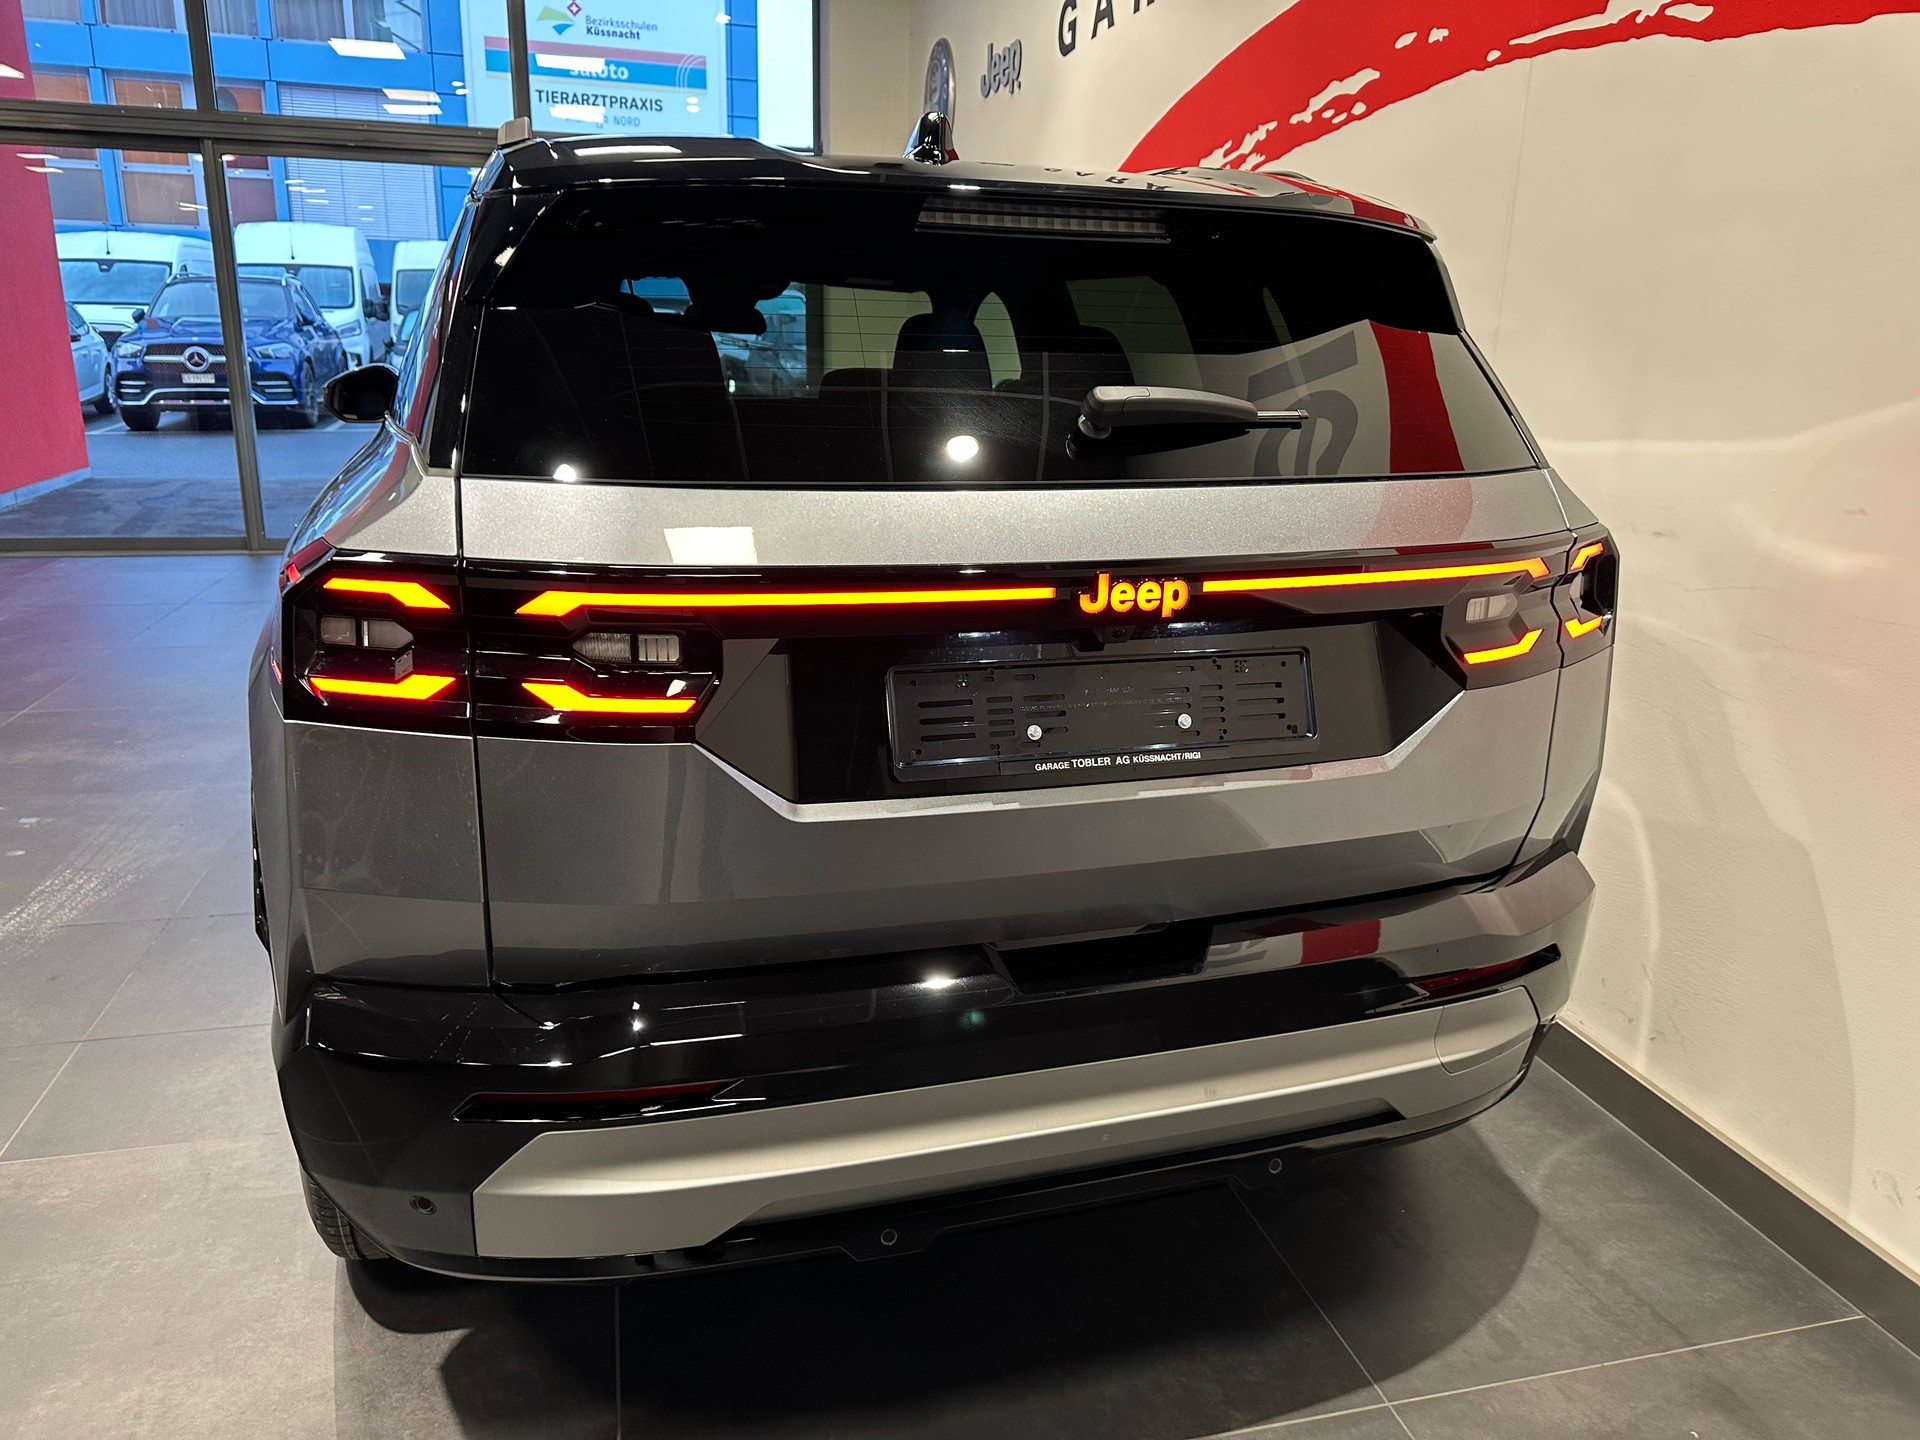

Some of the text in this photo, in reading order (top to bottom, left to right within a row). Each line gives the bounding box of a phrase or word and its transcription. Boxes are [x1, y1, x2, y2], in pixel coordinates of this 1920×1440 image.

[585, 15, 658, 32] Bezirksschulen
[586, 26, 641, 40] Küssnacht
[1058, 0, 1155, 57] GA
[981, 39, 1022, 98] Jeep
[535, 89, 663, 112] TIERARZTPRAXIS
[613, 115, 641, 128] NORD
[1078, 571, 1190, 618] Jeep
[1034, 751, 1201, 771] GARAGE TOBLER AG KÜSSNACHT/RIGI
